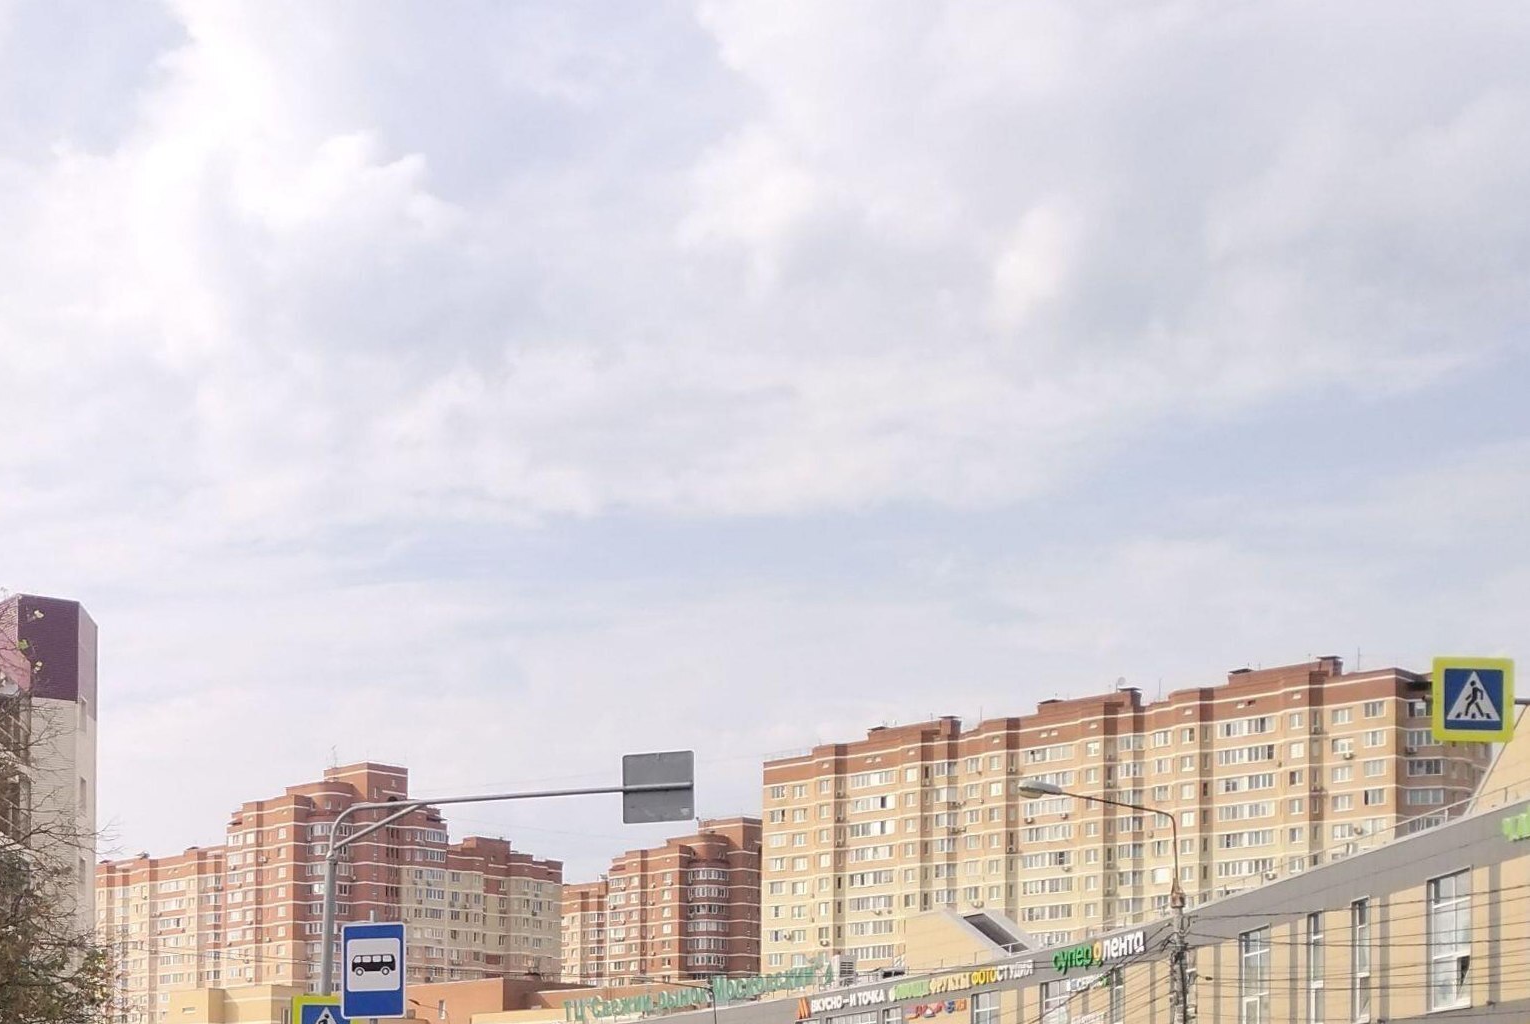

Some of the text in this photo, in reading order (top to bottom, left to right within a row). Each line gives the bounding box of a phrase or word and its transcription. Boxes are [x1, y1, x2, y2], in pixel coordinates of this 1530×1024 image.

[1053, 931, 1145, 975] супер лента
[930, 972, 970, 994] ФРУКТЫ
[972, 960, 1034, 985] ФОТОСТУДИЯ
[811, 995, 843, 1013] ВКУСНО
[858, 989, 885, 1006] ТОЧКА
